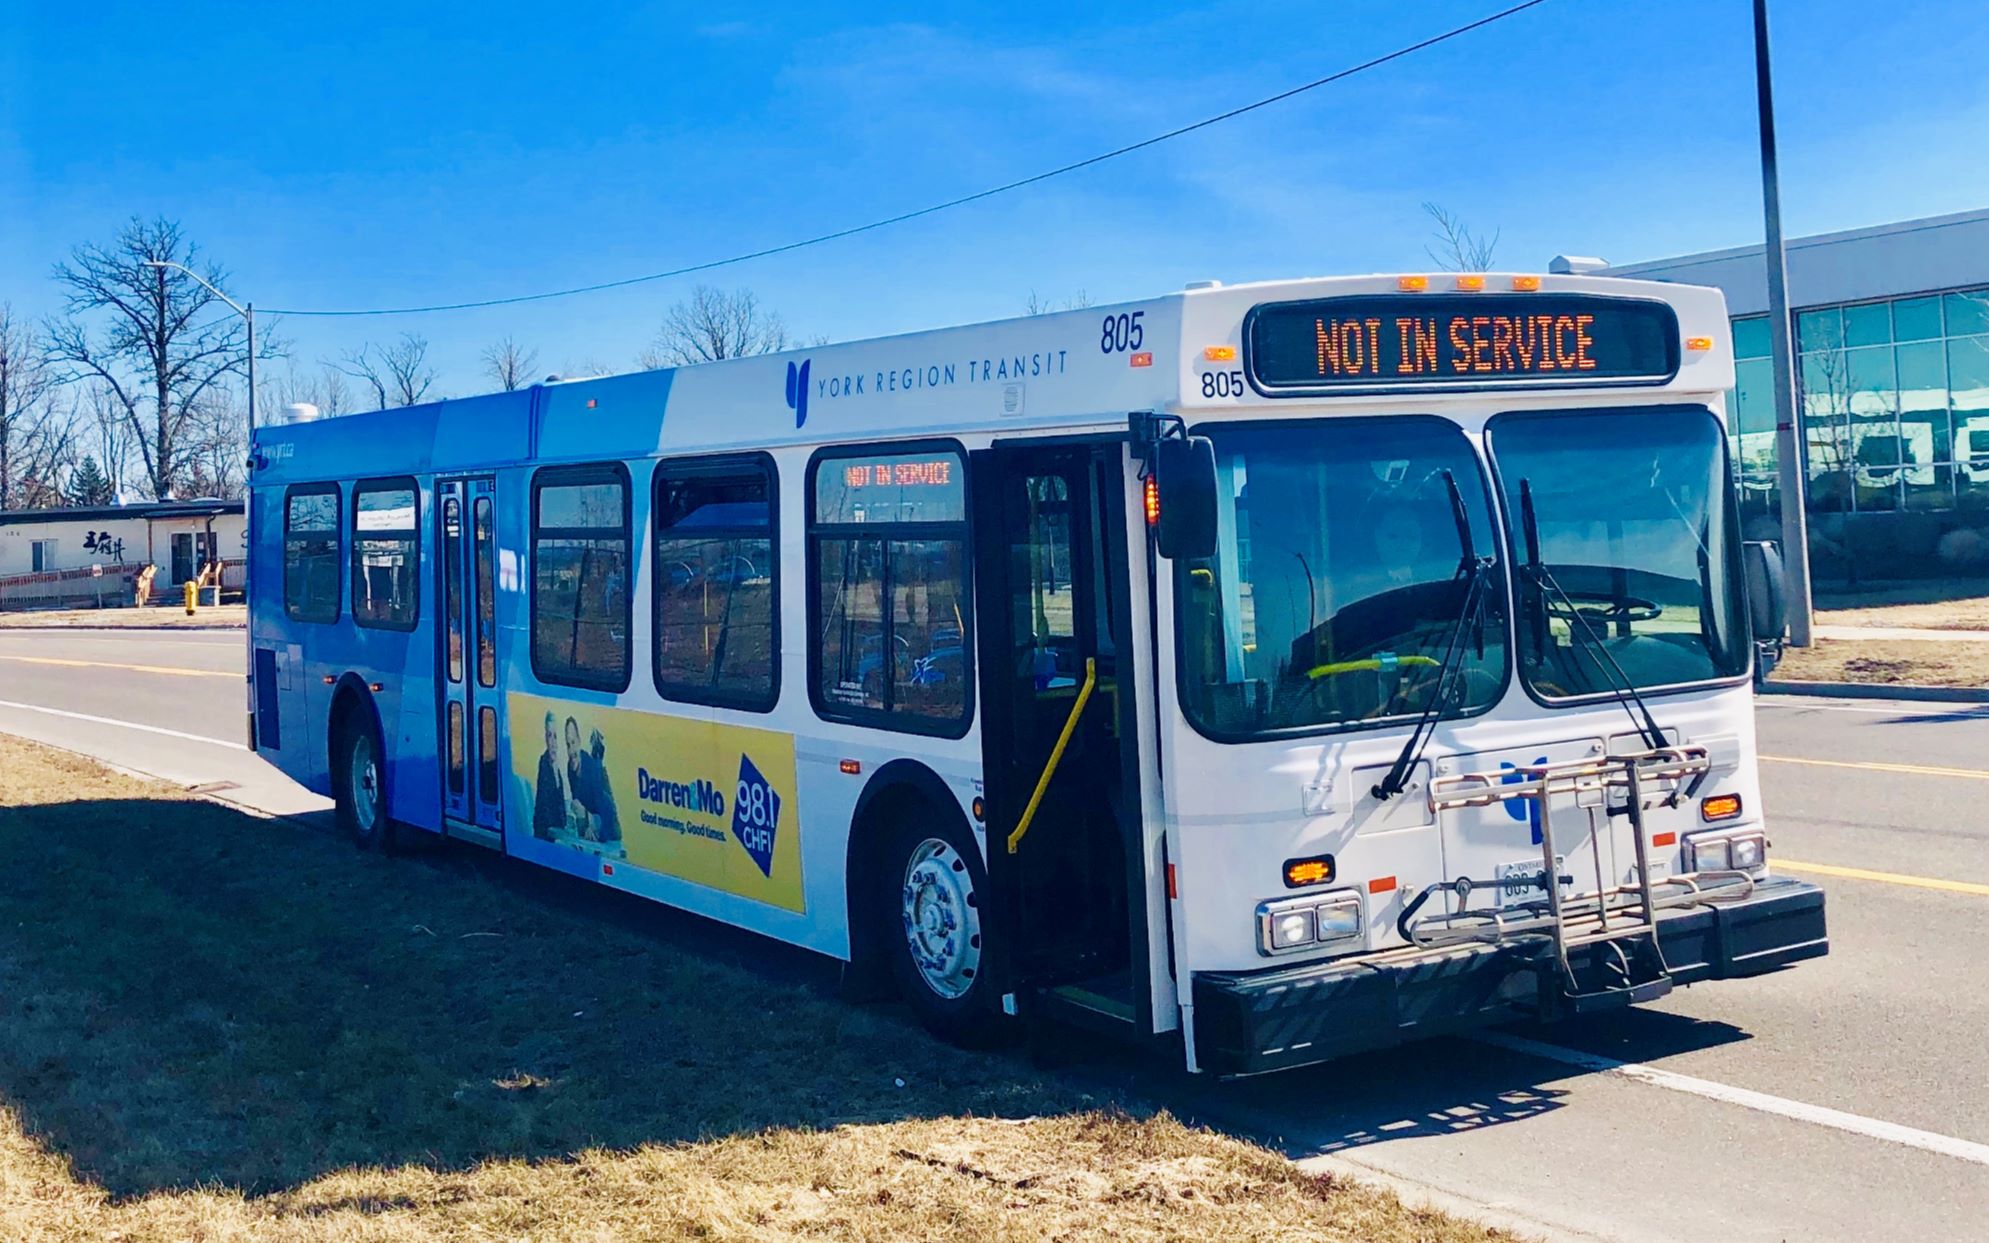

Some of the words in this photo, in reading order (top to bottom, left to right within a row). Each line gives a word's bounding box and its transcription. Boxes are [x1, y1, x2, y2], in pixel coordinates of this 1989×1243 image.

[1101, 311, 1145, 354] 805
[1316, 317, 1381, 374] NOT
[1397, 317, 1438, 373] IN
[1449, 315, 1596, 372] SERVICE
[818, 376, 865, 398] YORK
[876, 364, 956, 393] REGION
[969, 350, 1068, 382] TRANSIT
[1201, 371, 1244, 398] 805
[847, 466, 872, 487] NOT
[876, 464, 891, 485] IN
[895, 462, 950, 485] SERVICE
[737, 780, 775, 828] 98.1
[641, 809, 657, 824] Good
[686, 820, 705, 837] Good
[743, 826, 772, 854] CHFI
